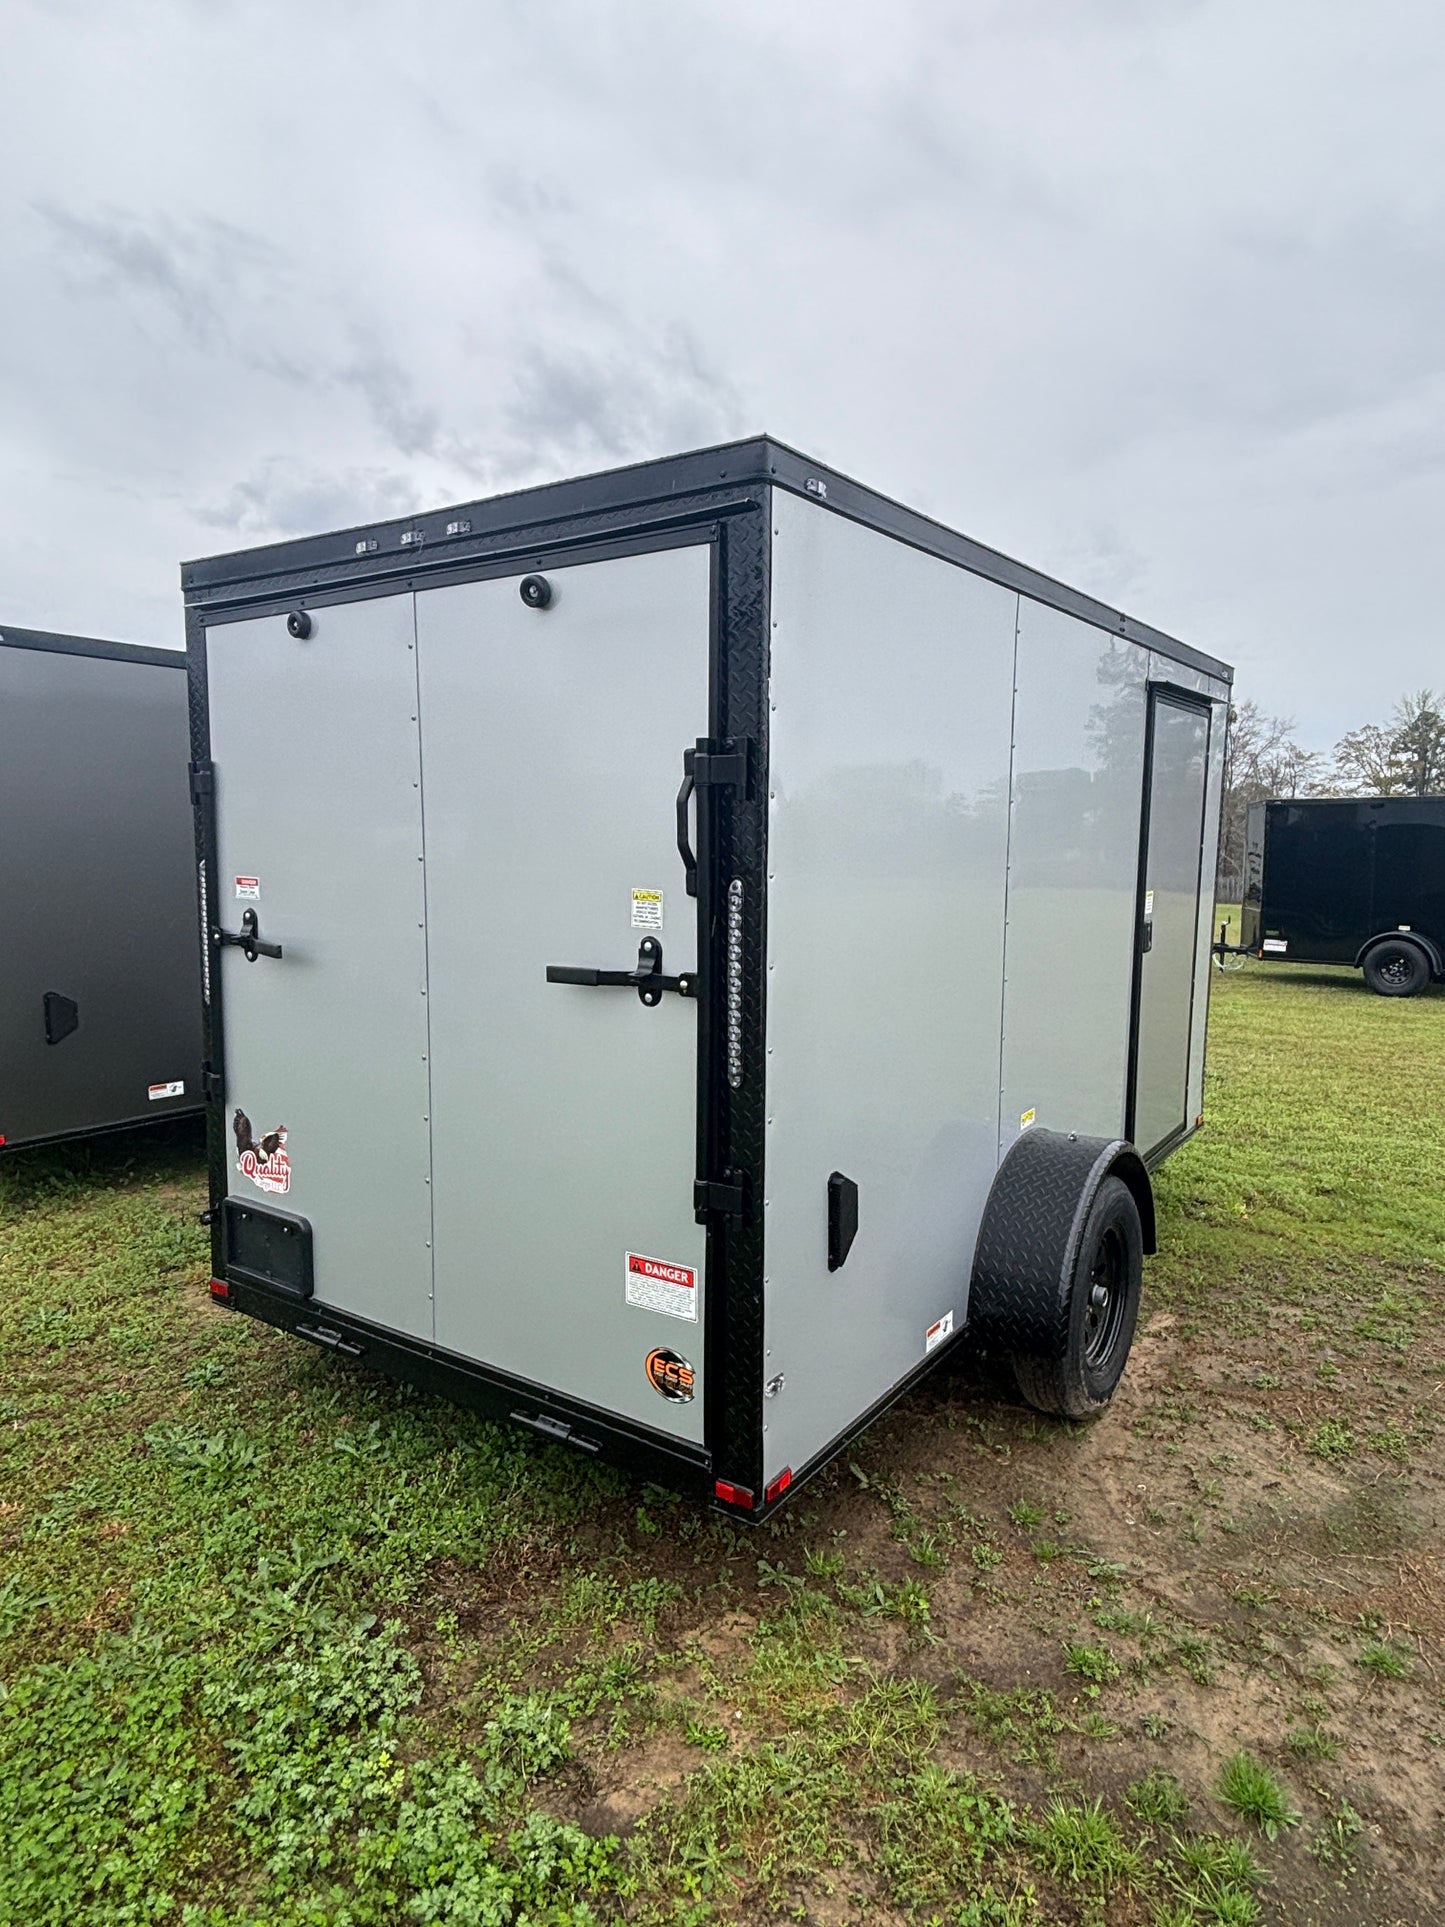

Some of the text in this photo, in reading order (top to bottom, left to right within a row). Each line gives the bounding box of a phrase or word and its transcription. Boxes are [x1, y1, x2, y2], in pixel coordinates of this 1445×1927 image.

[241, 1151, 290, 1191] Quality
[645, 1262, 689, 1284] DANGER
[653, 1357, 694, 1385] ECS
